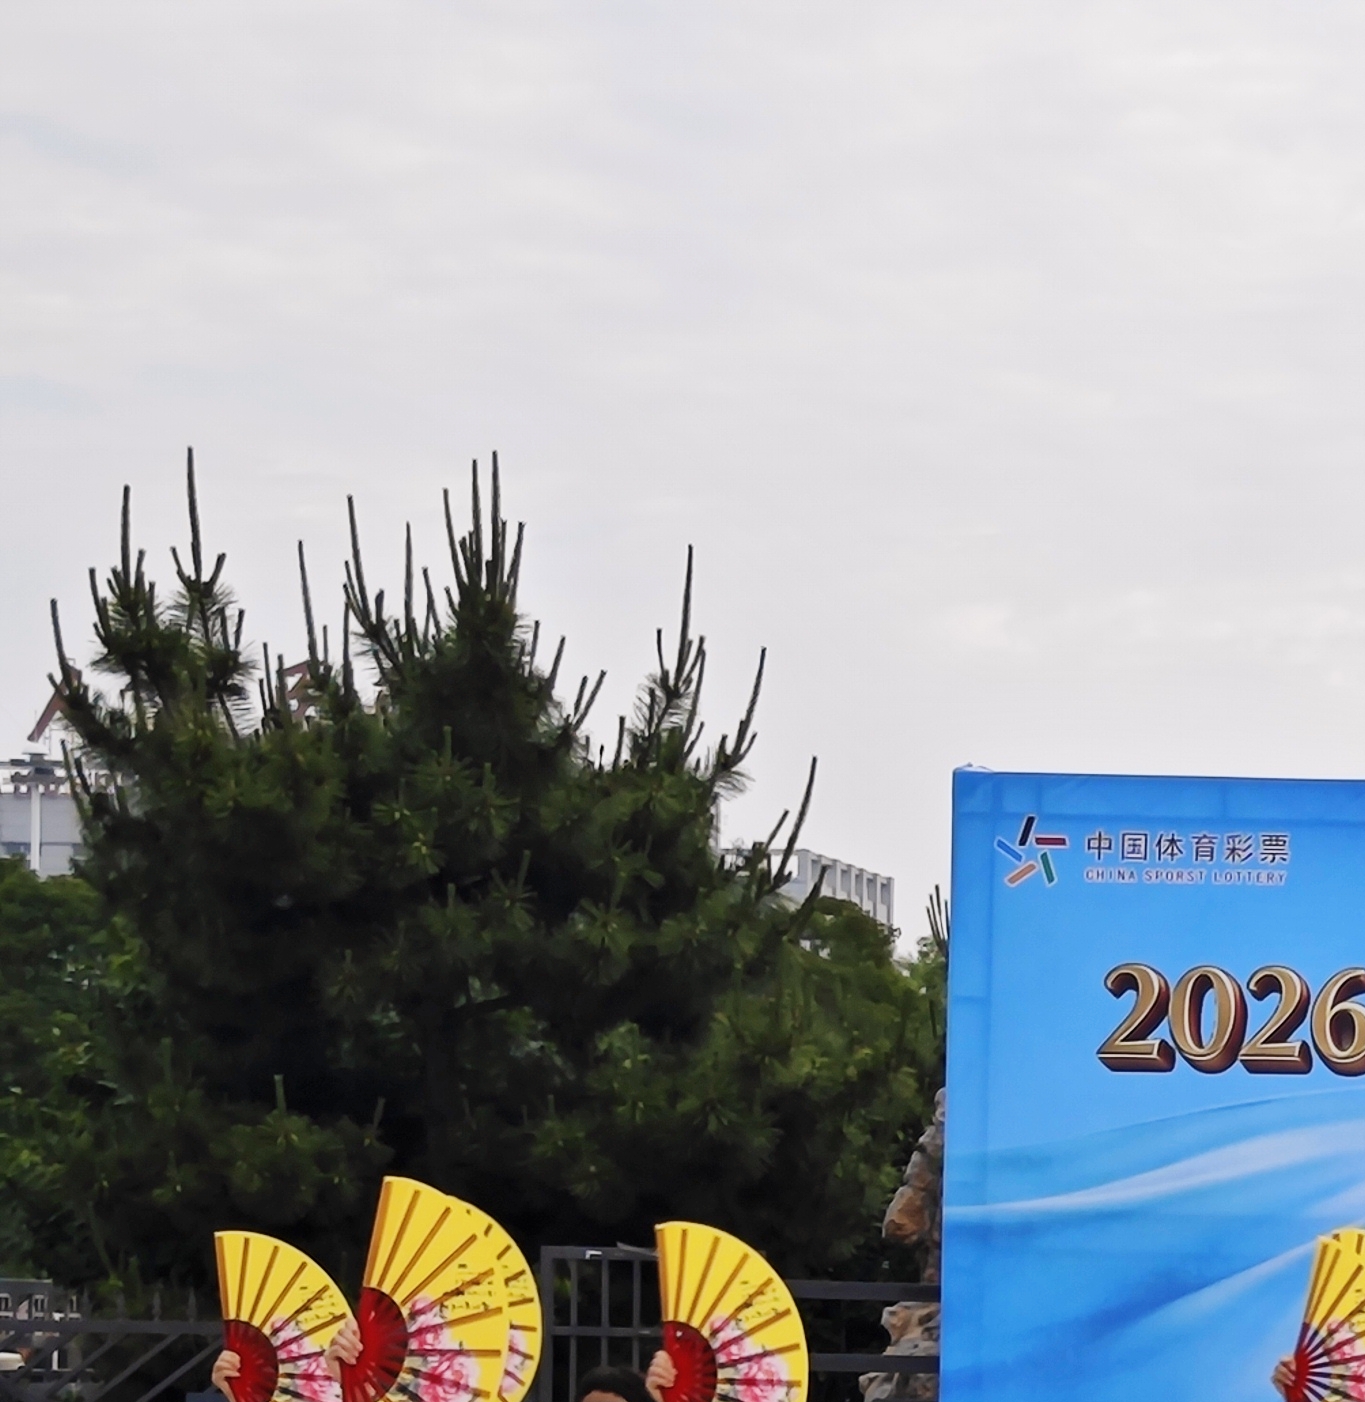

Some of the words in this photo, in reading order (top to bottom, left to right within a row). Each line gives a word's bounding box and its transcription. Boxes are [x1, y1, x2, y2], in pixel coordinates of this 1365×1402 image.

[1087, 831, 1289, 863] 中国体育彩票
[1085, 868, 1136, 881] CHINA
[1214, 870, 1285, 884] LOTTERY
